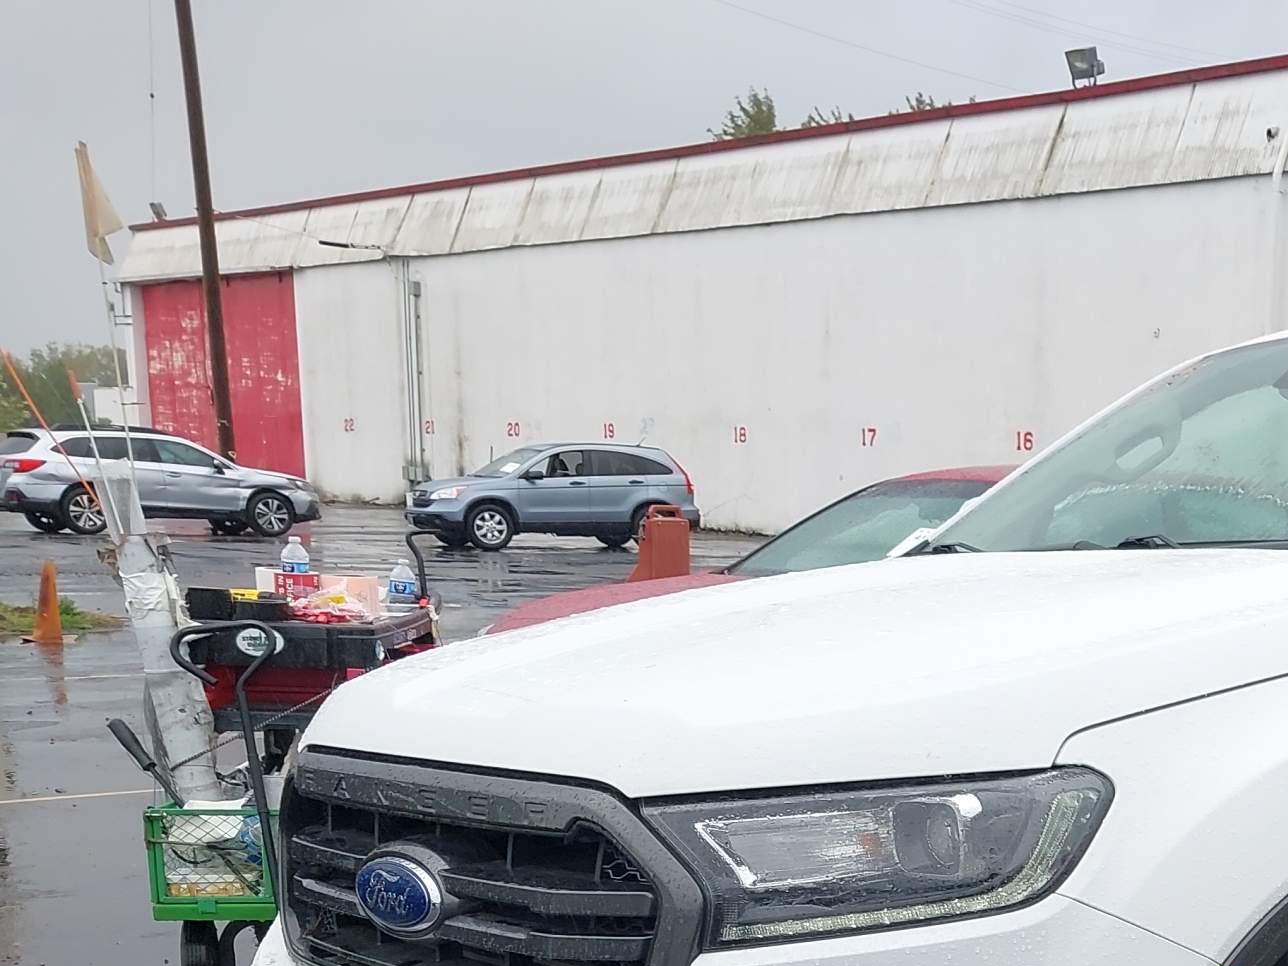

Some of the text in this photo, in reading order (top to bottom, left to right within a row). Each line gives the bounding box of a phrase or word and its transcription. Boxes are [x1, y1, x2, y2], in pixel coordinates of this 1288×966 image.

[343, 418, 356, 432] 22
[425, 420, 435, 434] 21
[507, 422, 520, 437] 20
[603, 423, 615, 438] 19
[734, 426, 747, 443] 18
[862, 427, 877, 447] 17
[1016, 431, 1034, 451] 16
[366, 868, 416, 915] Ford
